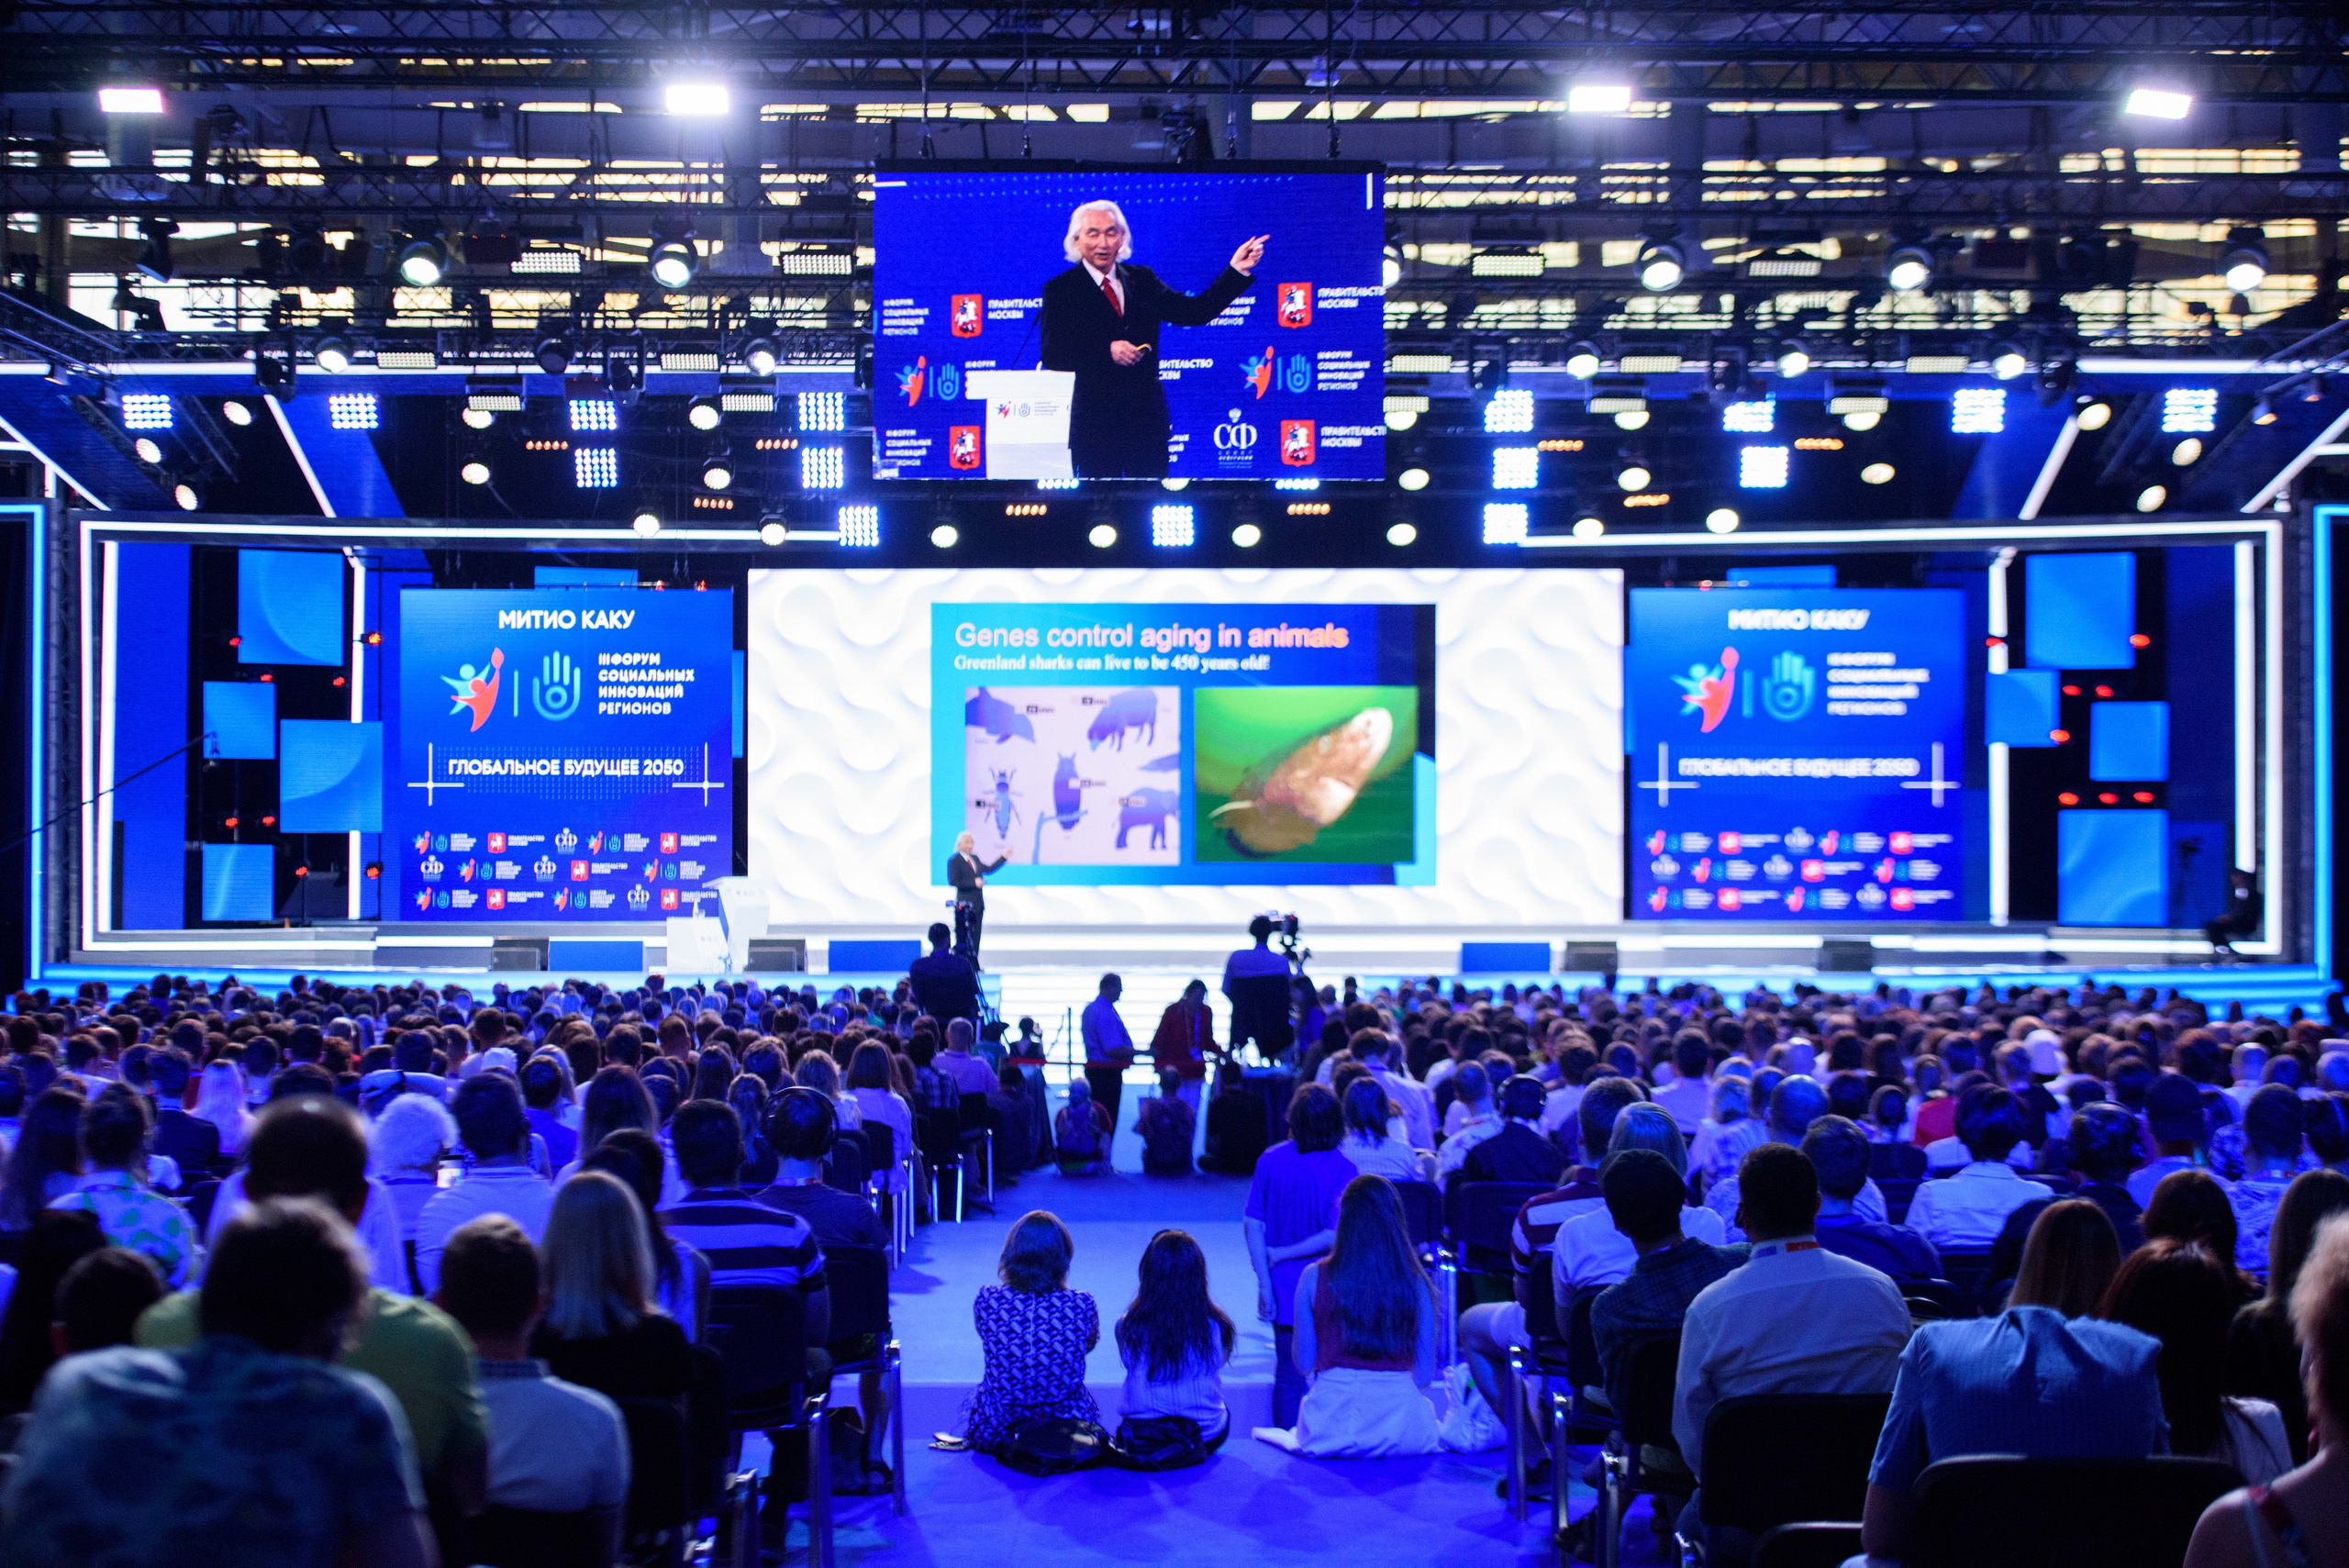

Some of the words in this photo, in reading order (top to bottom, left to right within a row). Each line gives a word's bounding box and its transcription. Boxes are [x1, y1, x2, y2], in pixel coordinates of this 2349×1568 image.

[987, 297, 1042, 308] ПРАВИТЕЛЬСТ
[1159, 358, 1213, 369] ВИТЕЛЬСТВО
[1214, 423, 1257, 450] СФ
[498, 609, 576, 629] МИТИО
[582, 610, 635, 629] КАКУ
[955, 622, 1040, 647] Genes
[1046, 623, 1133, 648] control
[1140, 623, 1211, 653] aging
[1219, 623, 1241, 648] in
[1248, 622, 1350, 649] animals
[954, 654, 1026, 670] Greenland
[1029, 654, 1074, 670] sharks
[1076, 658, 1102, 670] can
[1105, 654, 1131, 670] live
[1133, 657, 1150, 670] to
[1151, 654, 1169, 670] be
[1200, 658, 1240, 673] years
[598, 669, 695, 684] СОЦИАЛЬНЫХ
[598, 684, 684, 699] ИННОВАЦИЙ
[598, 702, 672, 715] РЕГИОНОВ
[448, 759, 561, 775] ГЛОБАЛЬНОЕ
[563, 759, 640, 777] БУДУЩЕЕ
[642, 759, 684, 775] 2050
